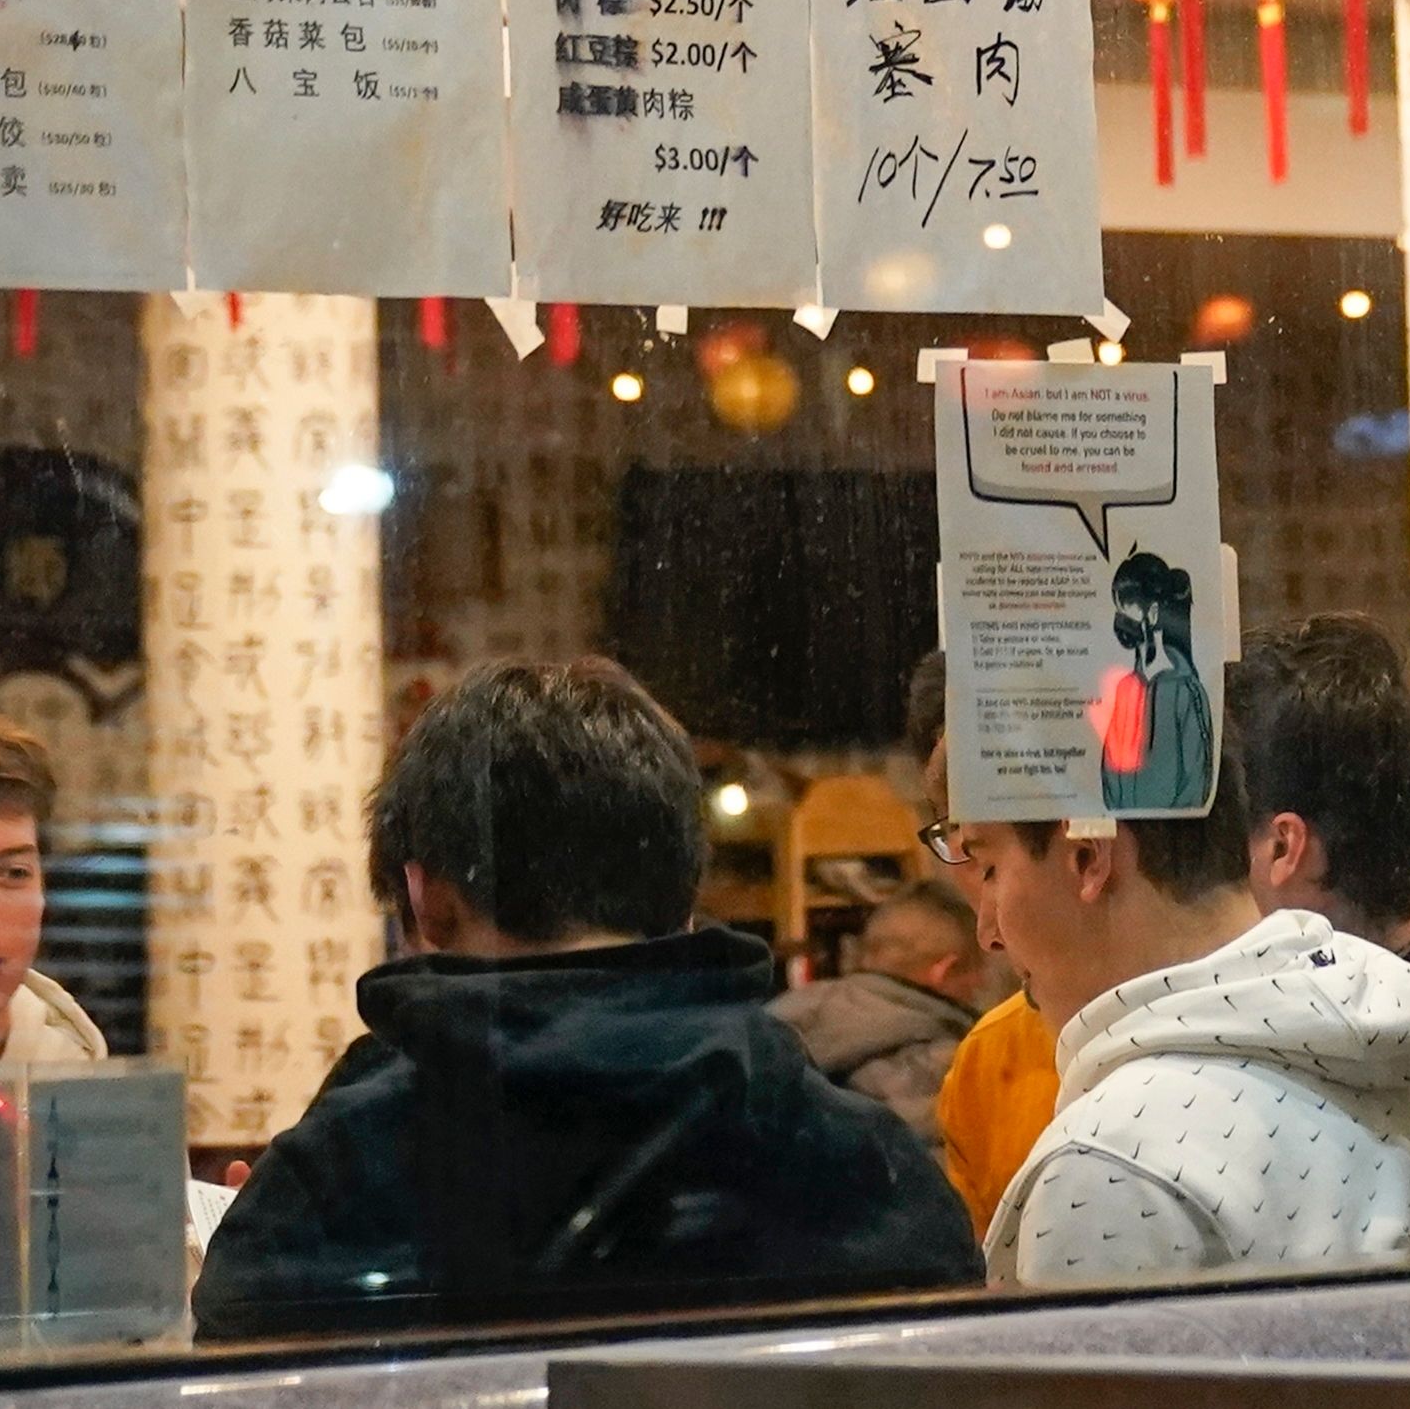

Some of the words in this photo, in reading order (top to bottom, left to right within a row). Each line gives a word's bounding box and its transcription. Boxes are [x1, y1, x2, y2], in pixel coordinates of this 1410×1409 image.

[228, 17, 367, 52] 香菇菜包
[651, 38, 758, 73] $2.00/个
[229, 66, 381, 101] 八宝饭
[655, 143, 759, 178] $3.00/个
[596, 199, 682, 234] 好吃来
[1091, 390, 1112, 401] NOT
